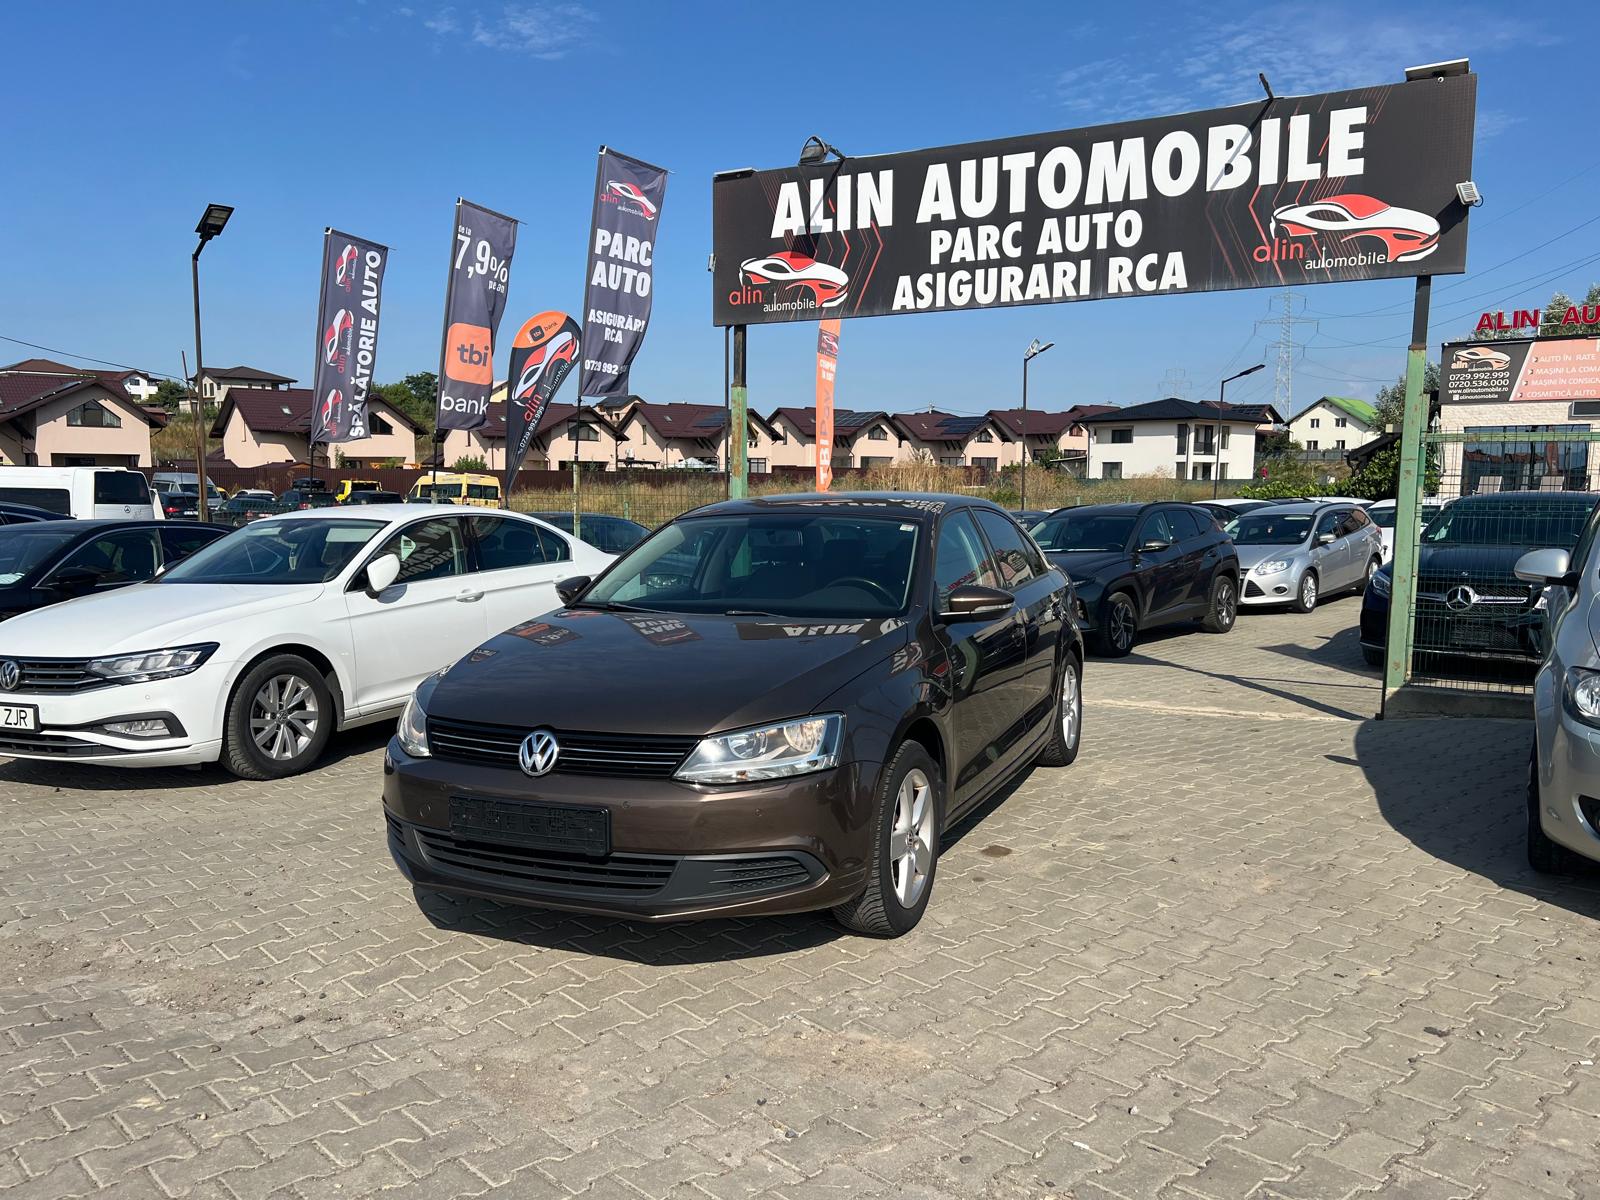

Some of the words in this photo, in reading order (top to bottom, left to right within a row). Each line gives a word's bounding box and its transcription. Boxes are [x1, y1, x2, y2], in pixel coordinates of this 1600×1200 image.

[770, 168, 893, 239] ALIN
[915, 106, 1368, 224] AUTOMOBILE
[594, 228, 652, 267] PARC
[930, 221, 1023, 265] PARC
[1036, 209, 1143, 256] AUTO
[455, 234, 508, 283] 7,9%
[1253, 237, 1304, 262] alin
[1305, 246, 1387, 270] automobile
[361, 250, 381, 315] AUTO
[591, 261, 652, 297] AUTO
[892, 258, 1092, 311] ASIGURARI
[1107, 251, 1188, 294] RCA
[729, 285, 763, 306] alin
[763, 292, 816, 312] automobile
[588, 308, 646, 333] ASIGURĂRI
[1476, 309, 1540, 332] ALIN
[604, 327, 623, 344] RCA
[457, 343, 490, 367] tbi
[348, 317, 377, 437] SPĂLĂTORIE
[602, 362, 619, 375] 992
[1449, 371, 1510, 381] 0729.992.999
[1448, 379, 1510, 388] 0720.536.000
[440, 391, 489, 415] bank
[524, 394, 544, 421] alin
[4, 708, 28, 727] ZJR
